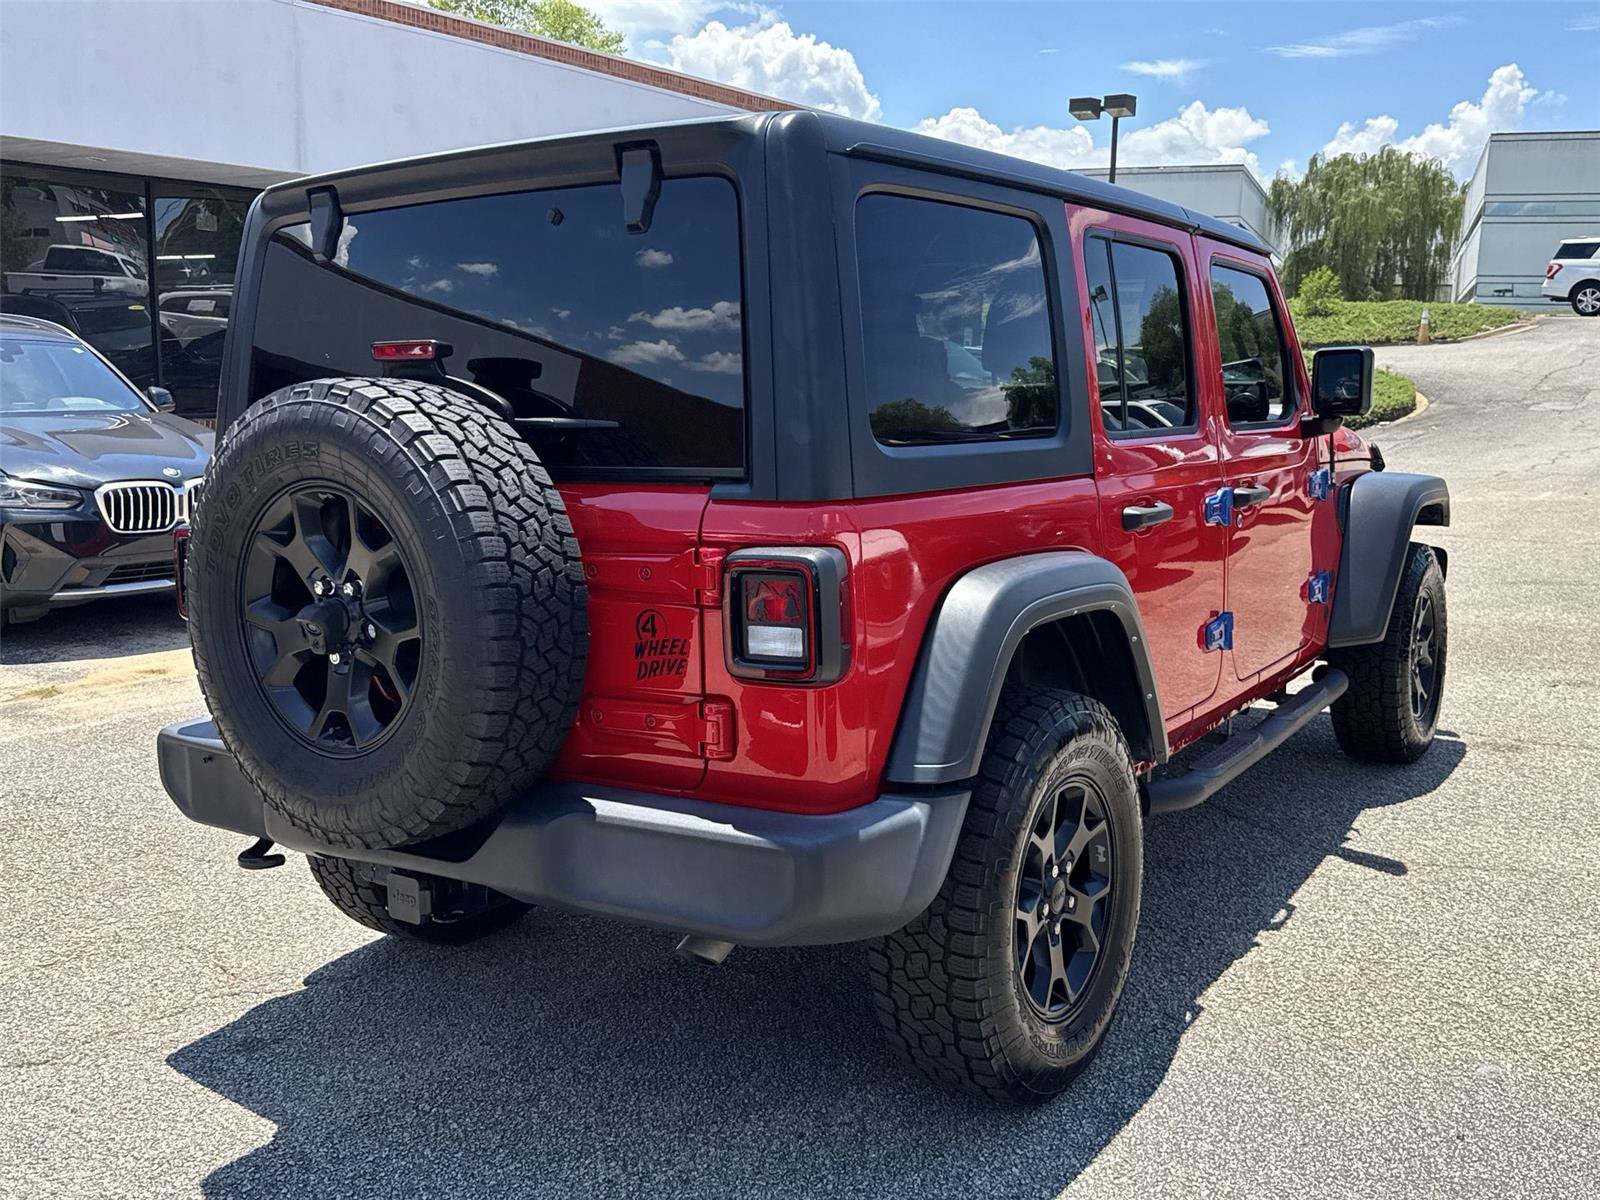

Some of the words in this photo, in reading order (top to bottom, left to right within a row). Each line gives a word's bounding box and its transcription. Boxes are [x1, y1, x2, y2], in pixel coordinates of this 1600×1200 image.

[206, 482, 242, 577] TOYO
[241, 441, 320, 488] TIRES
[641, 614, 657, 637] 4
[635, 638, 688, 659] WHEEL
[636, 658, 688, 681] DRIVE
[392, 889, 417, 908] Jeep
